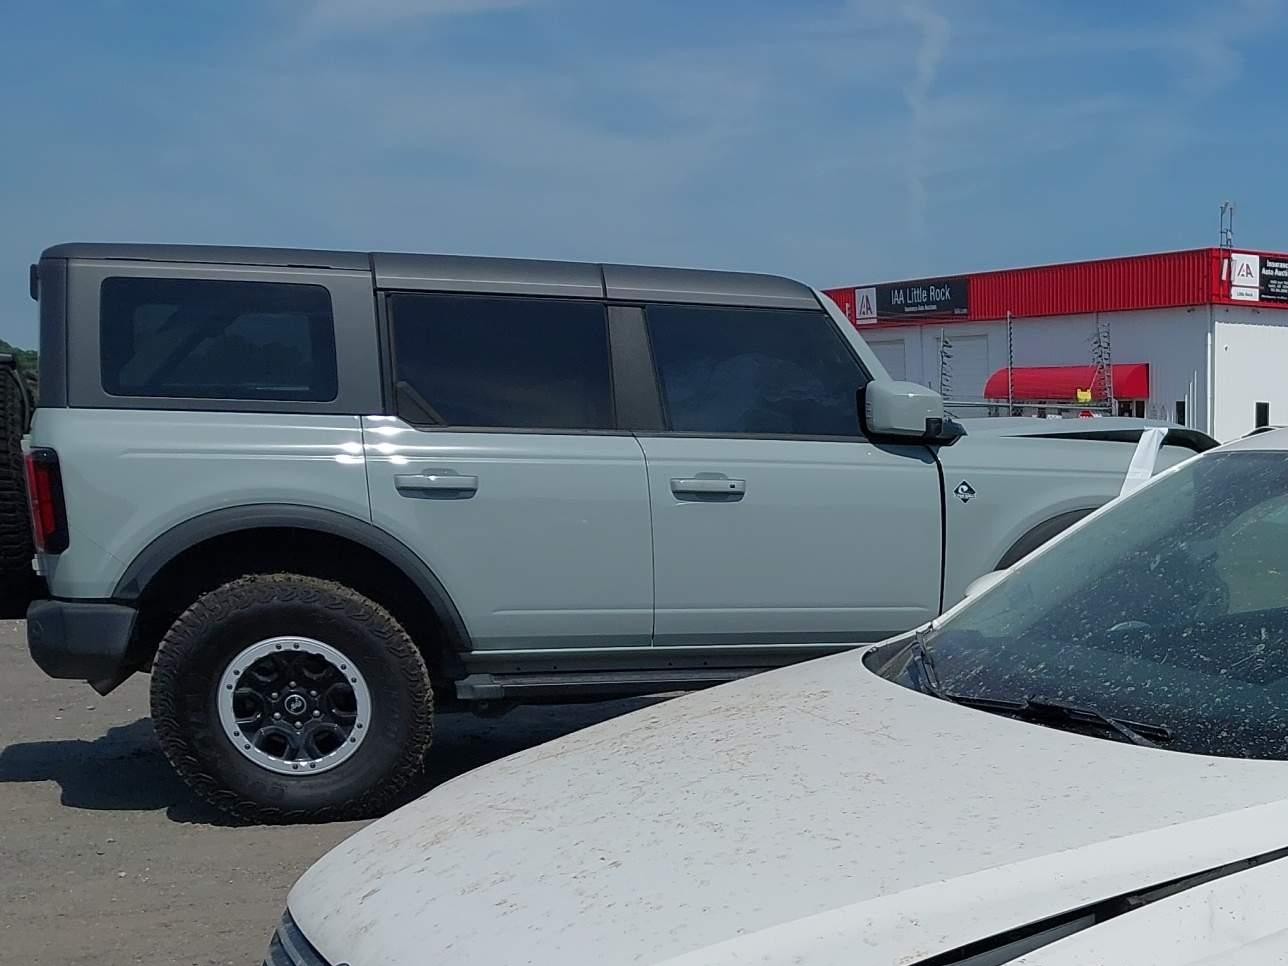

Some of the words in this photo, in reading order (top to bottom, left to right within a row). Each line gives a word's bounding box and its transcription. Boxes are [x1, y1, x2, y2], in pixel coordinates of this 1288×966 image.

[891, 289, 905, 305] IAA
[906, 286, 928, 303] Little
[929, 284, 951, 301] Rock
